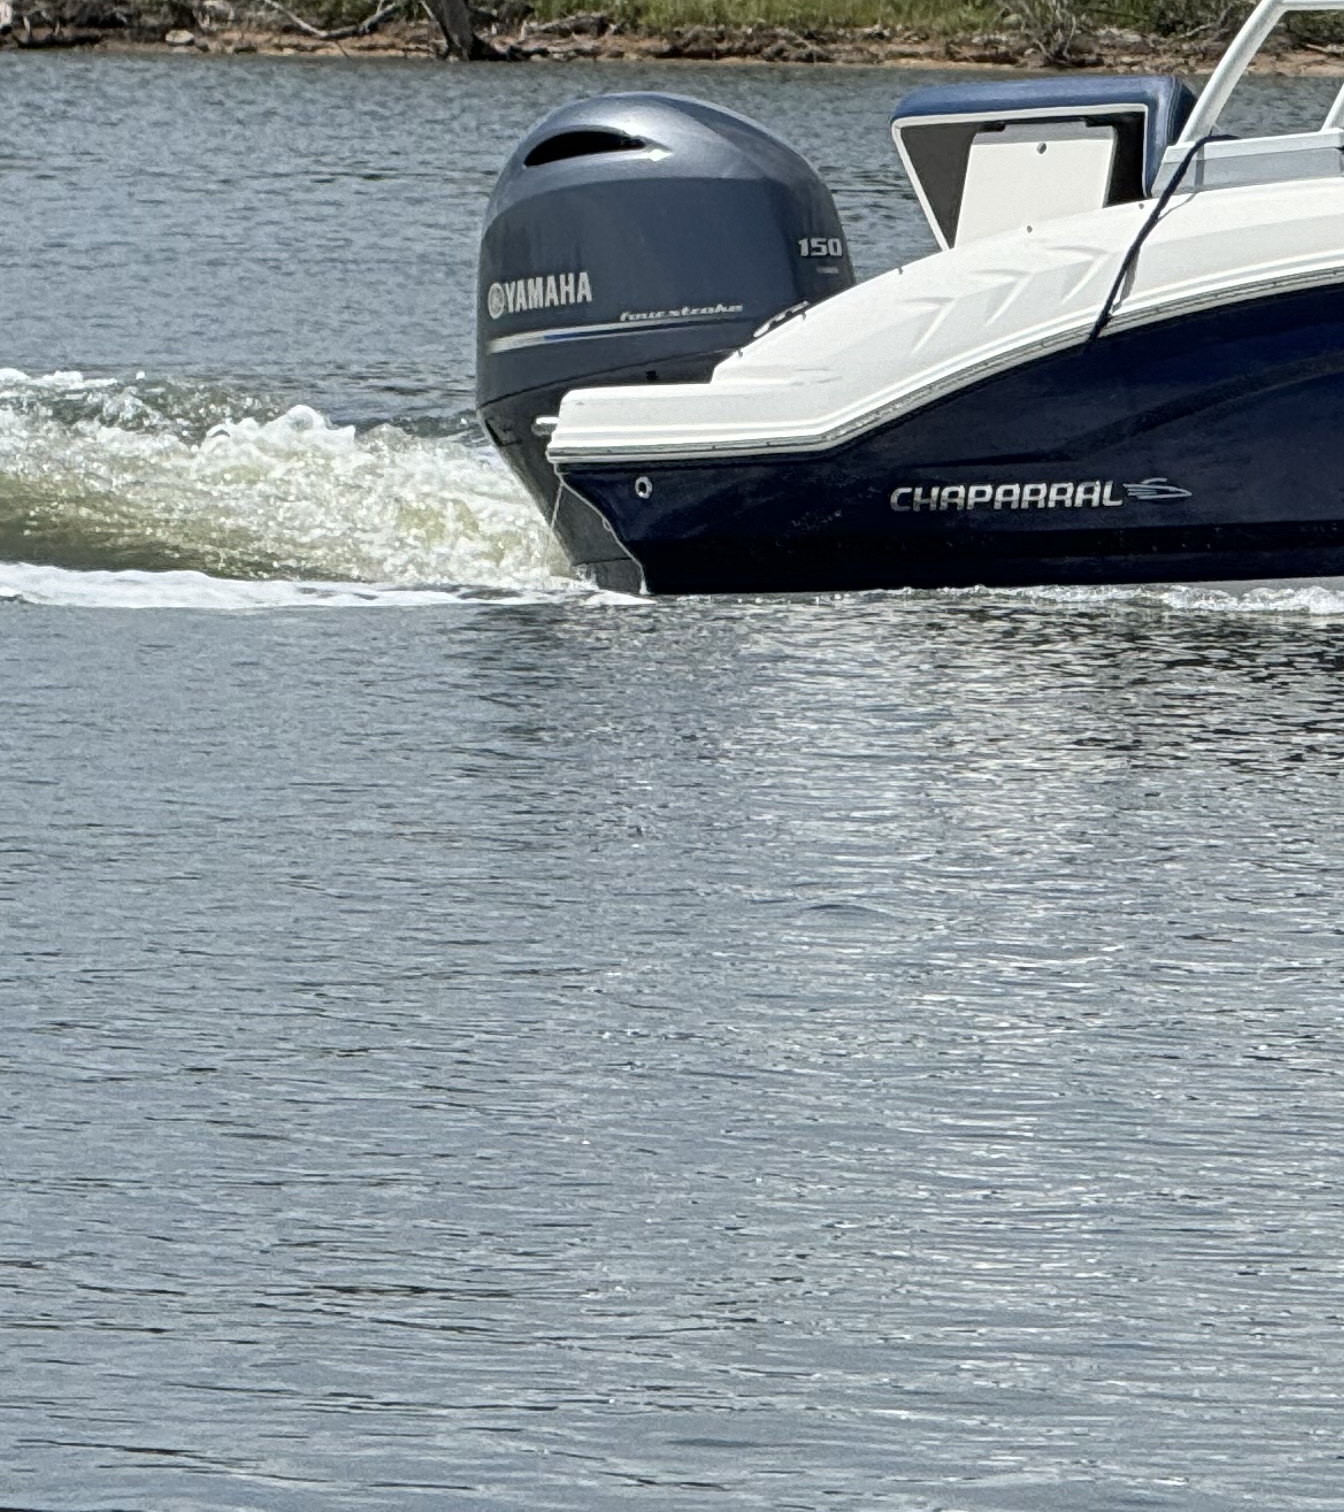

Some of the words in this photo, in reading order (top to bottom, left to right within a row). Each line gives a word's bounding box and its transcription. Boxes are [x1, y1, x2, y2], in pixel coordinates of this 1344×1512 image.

[798, 237, 843, 257] 150
[503, 271, 593, 314] YAMAHA
[889, 480, 1124, 512] CHAPARRAL
